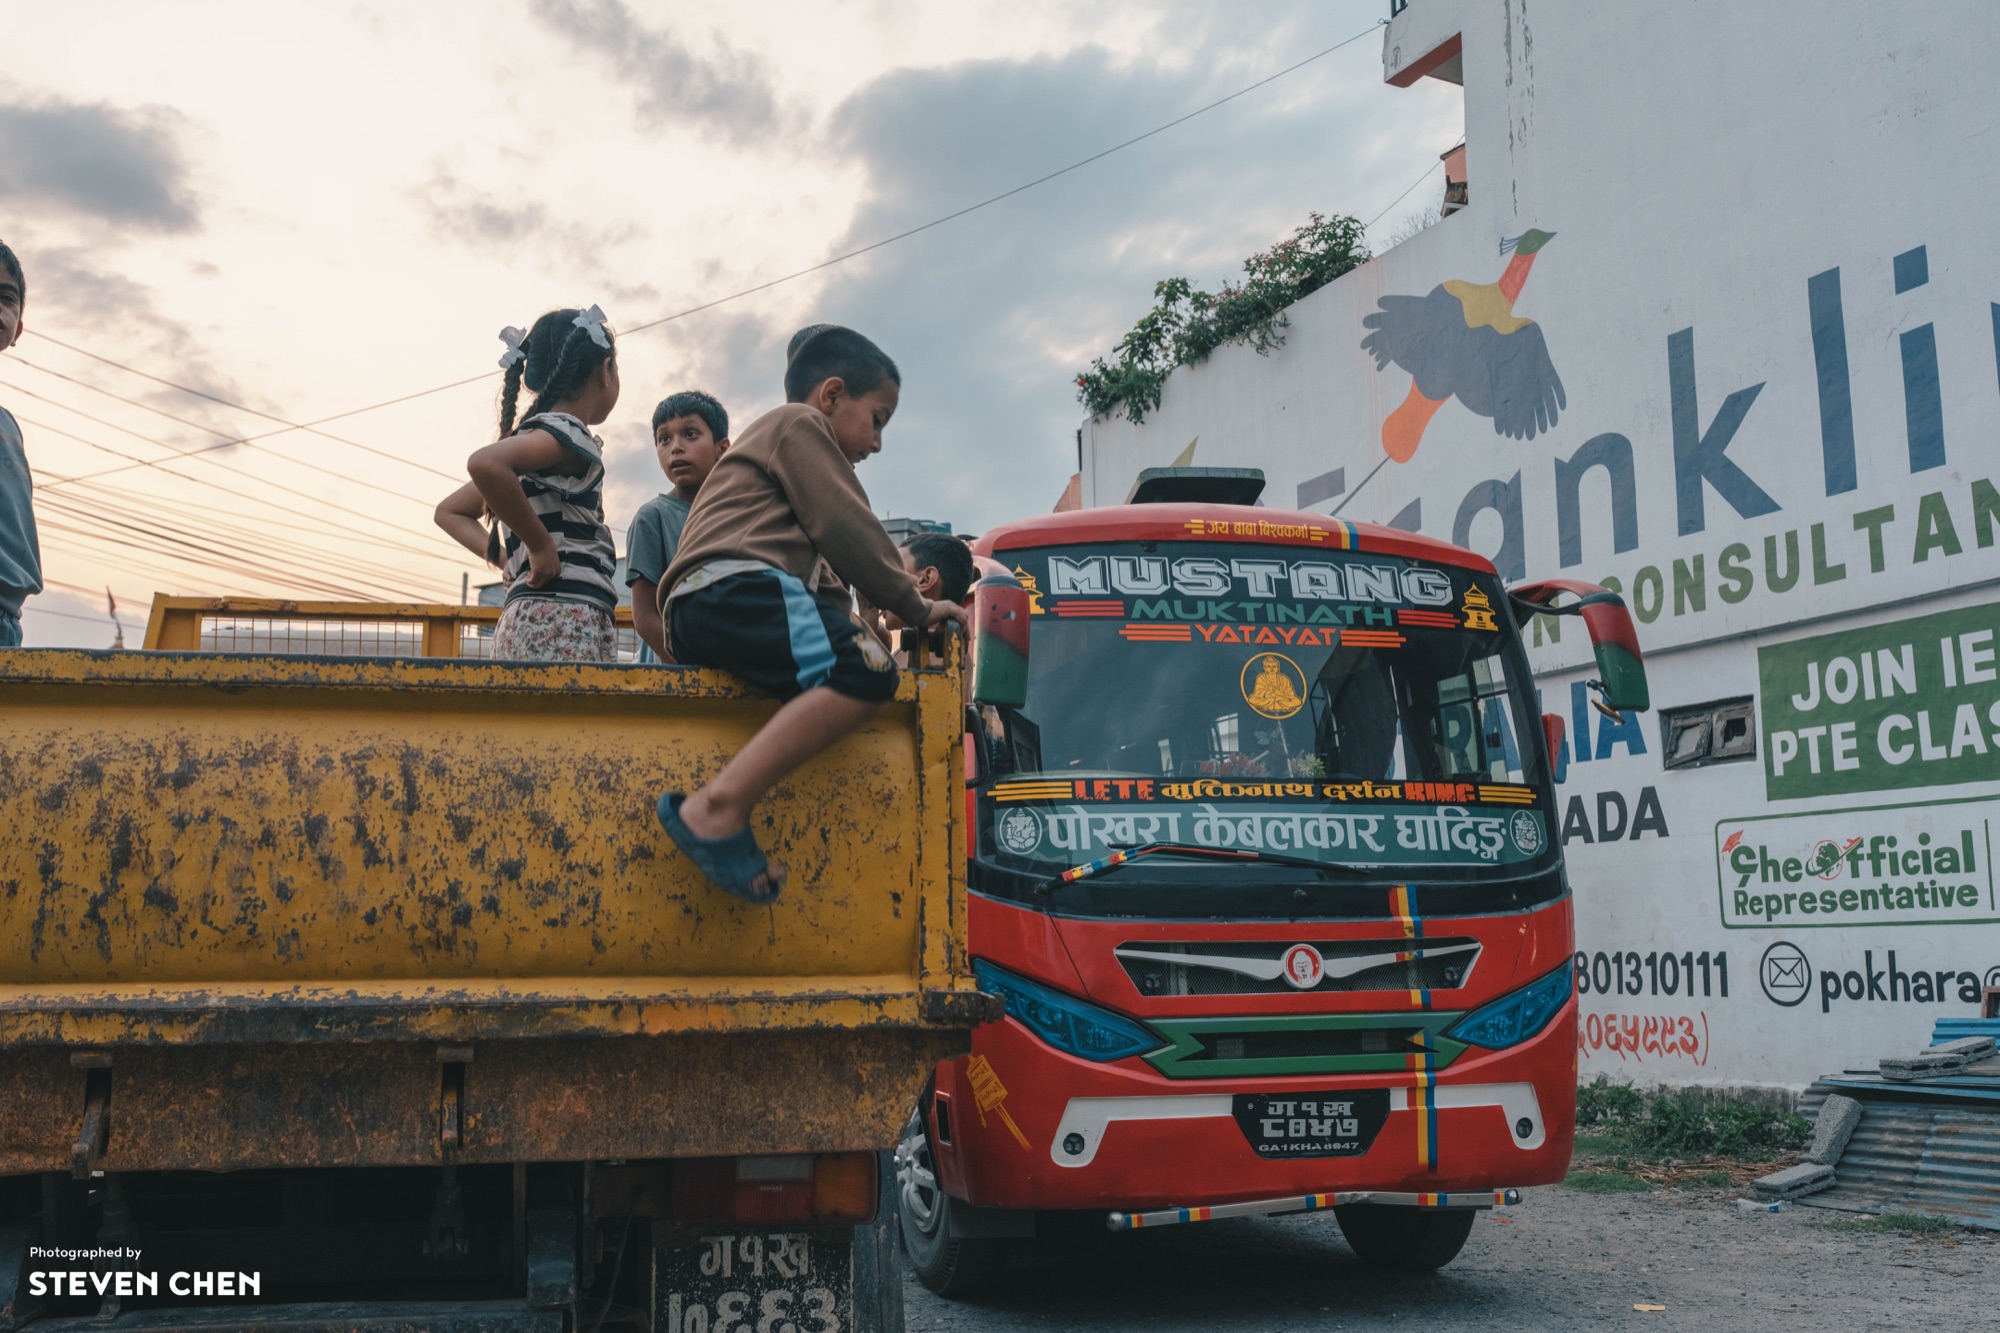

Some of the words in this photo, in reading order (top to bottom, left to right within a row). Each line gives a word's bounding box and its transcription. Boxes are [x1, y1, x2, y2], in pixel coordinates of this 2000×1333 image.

[1206, 520, 1229, 535] जय
[1233, 521, 1257, 536] बाबा
[1599, 478, 2000, 624] ONSULTAN
[1048, 556, 1454, 607] MUSTANG
[1131, 599, 1393, 627] MUKTINATH
[1194, 624, 1336, 647] YATAYAT
[1791, 644, 1917, 712] JOIN
[1940, 629, 1997, 687] IE
[1771, 721, 1860, 777] PTE
[1074, 780, 1155, 801] LETE
[1403, 781, 1476, 803] KING
[1045, 805, 1182, 852] पोखरा
[1192, 803, 1386, 852] केबलकार
[1733, 879, 1979, 922] Representative
